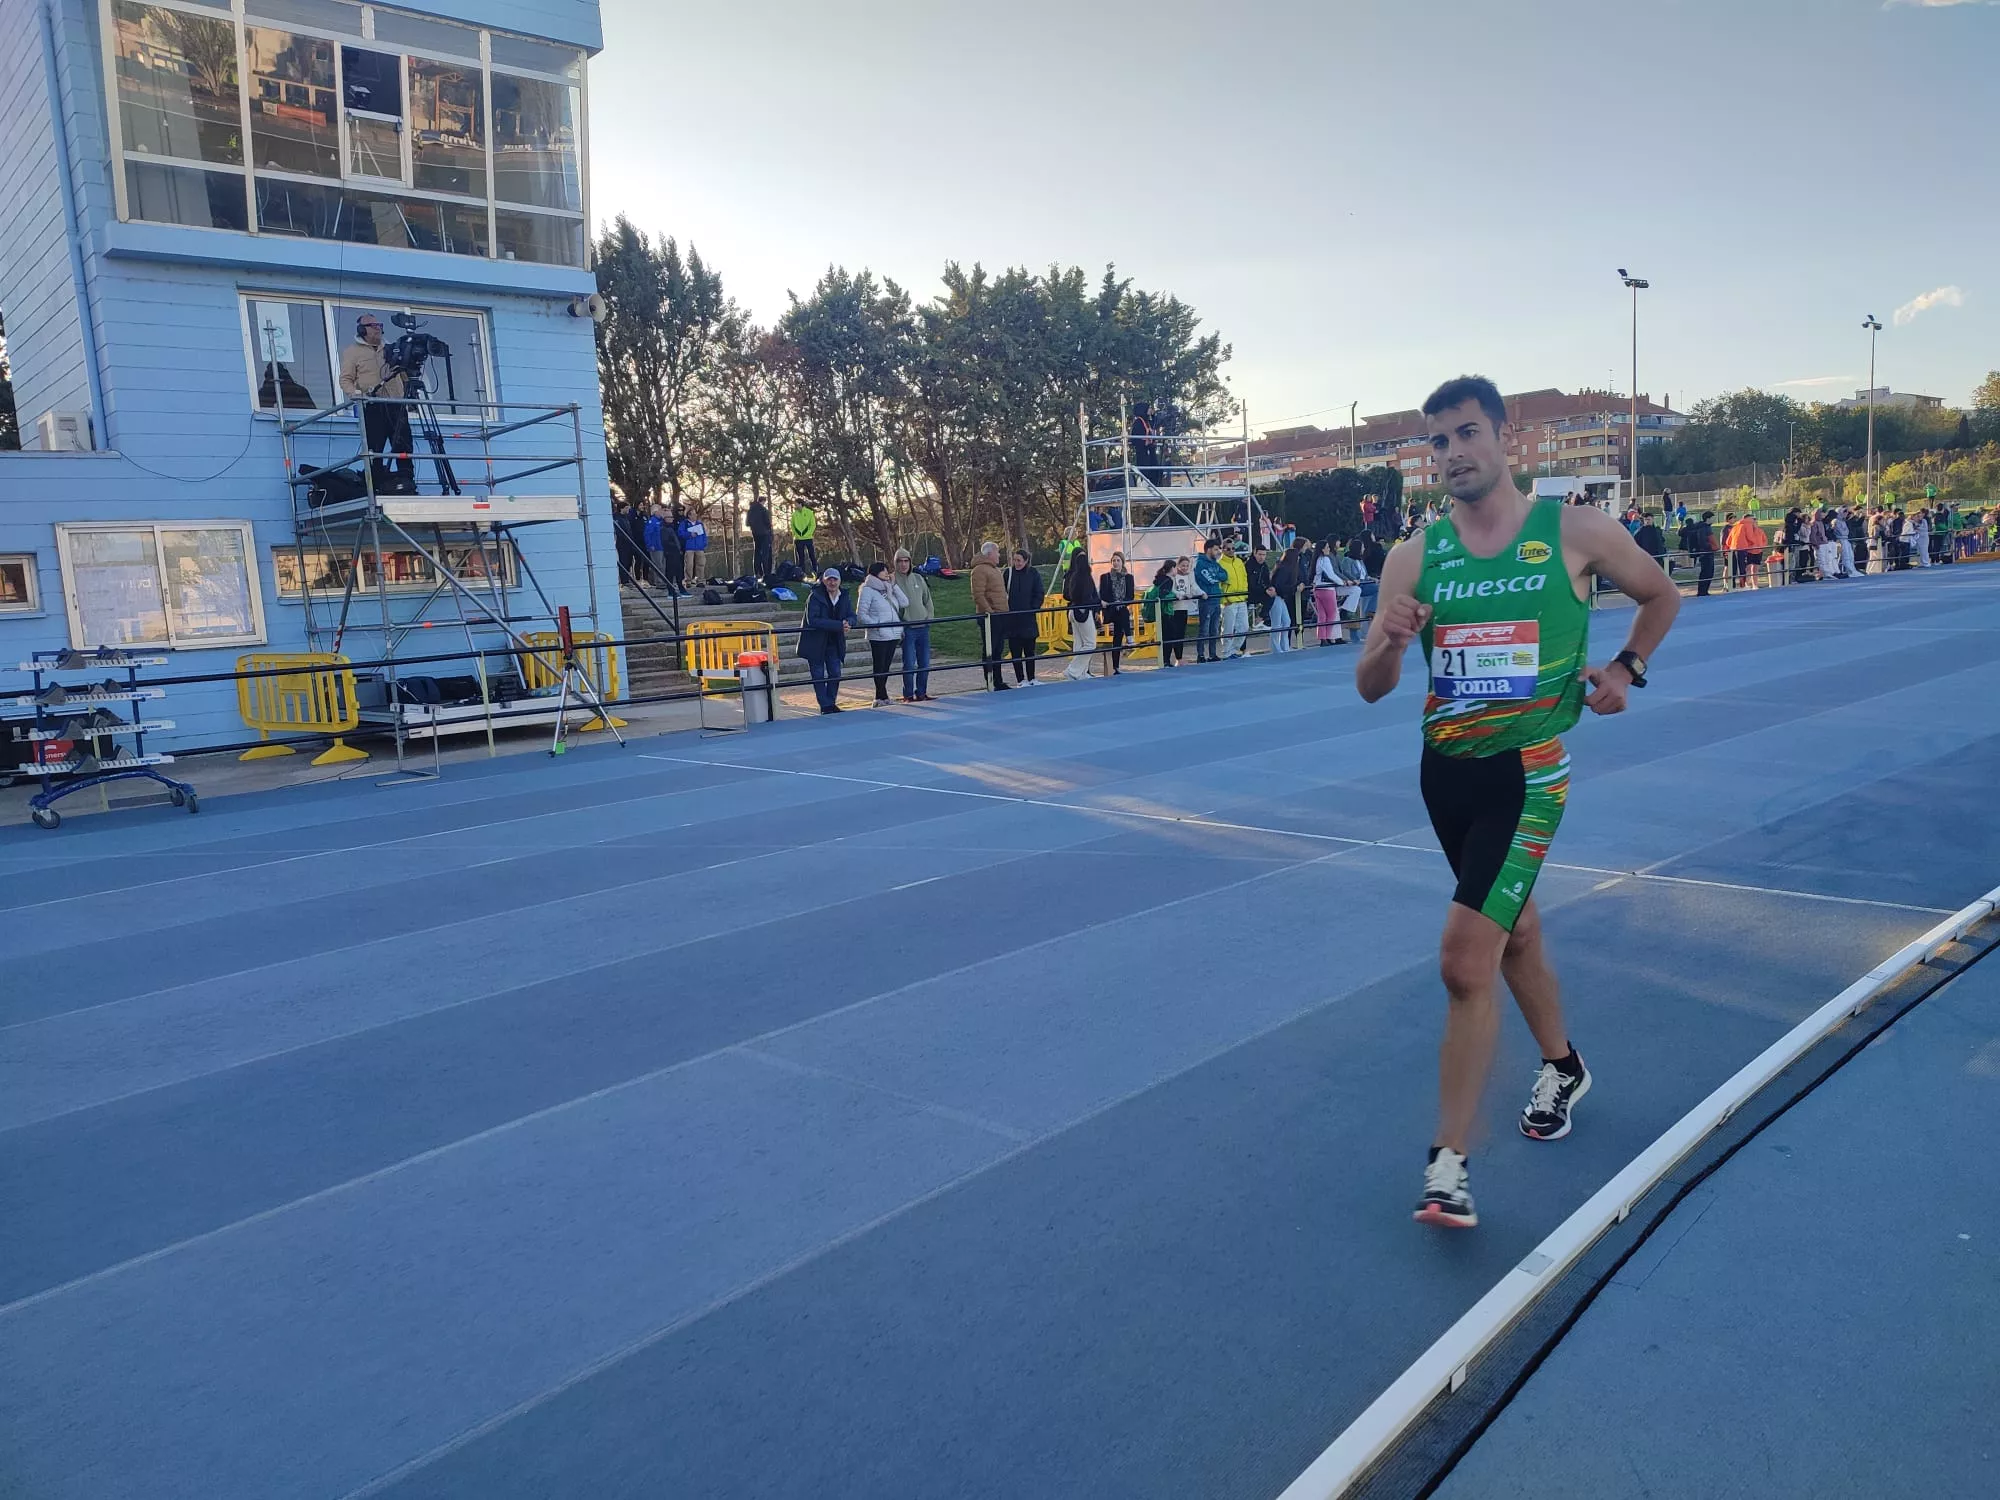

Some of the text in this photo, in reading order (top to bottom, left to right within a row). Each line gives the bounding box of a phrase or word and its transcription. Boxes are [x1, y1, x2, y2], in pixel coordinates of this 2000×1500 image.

[1433, 574, 1547, 603] Huesca
[1442, 649, 1466, 676] 21
[1477, 657, 1508, 667] ZOITI
